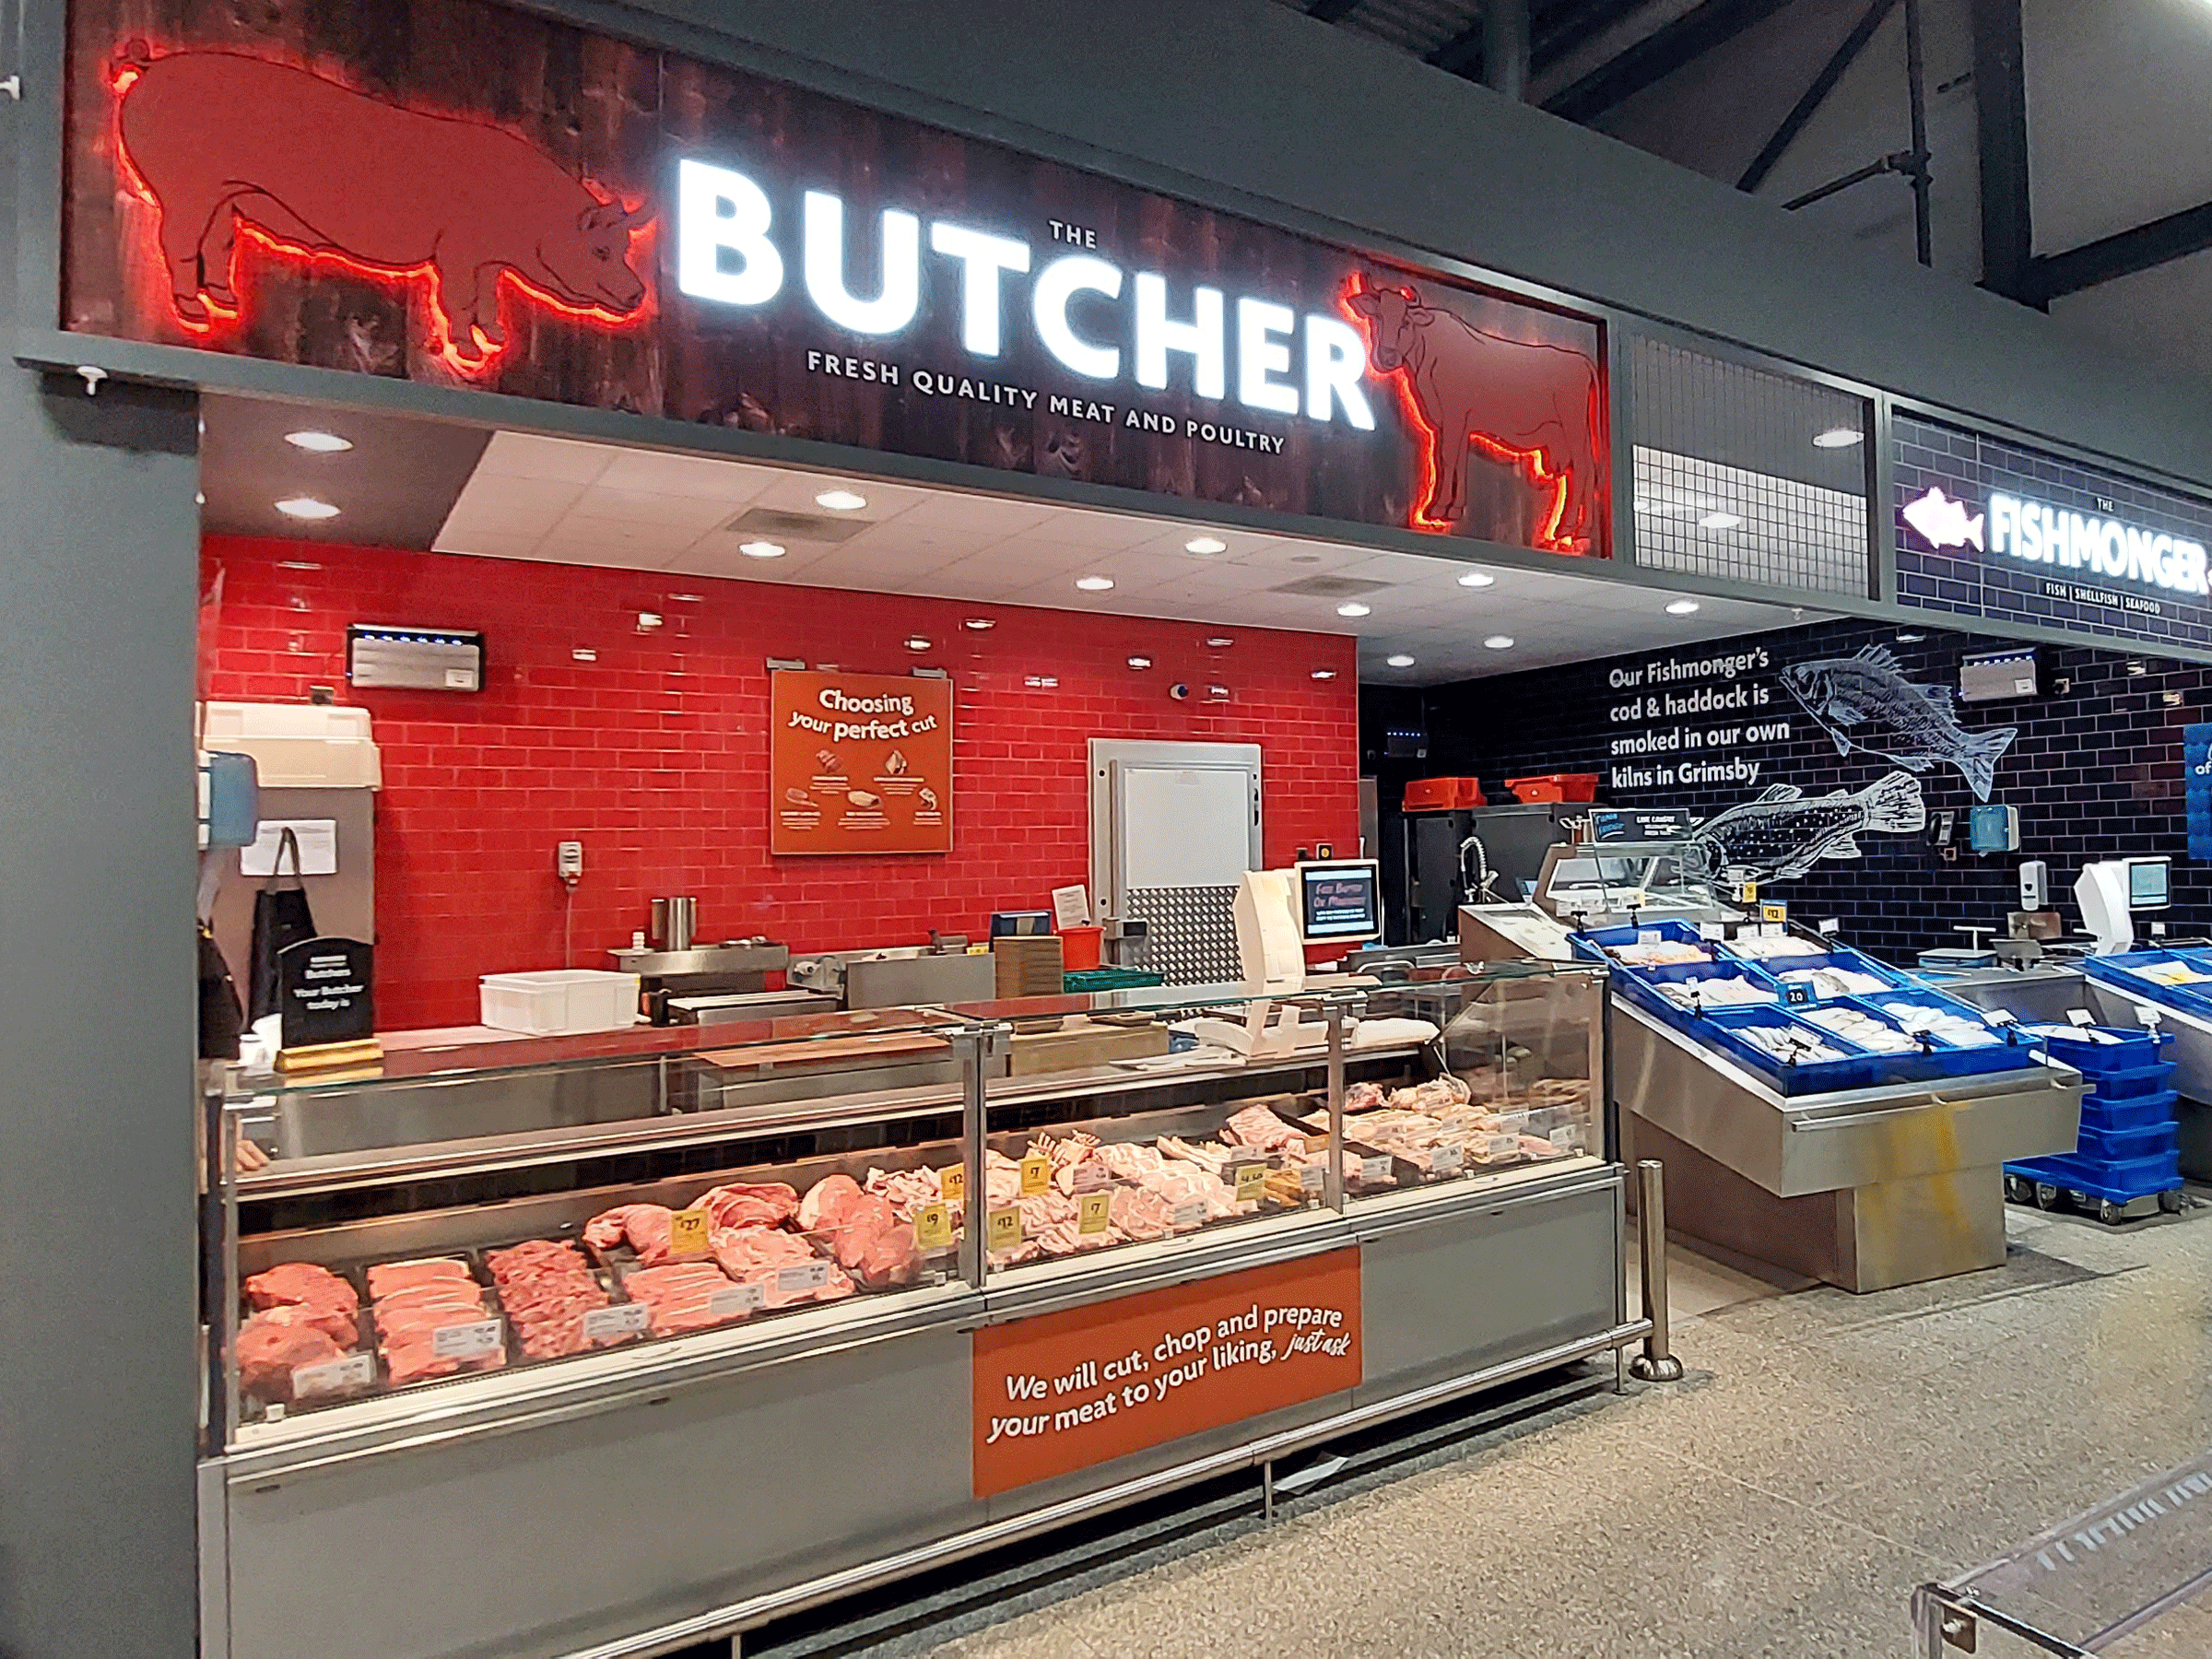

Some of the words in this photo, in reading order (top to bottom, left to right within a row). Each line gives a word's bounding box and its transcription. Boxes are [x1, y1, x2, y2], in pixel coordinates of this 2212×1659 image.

[1050, 219, 1097, 250] THE
[677, 159, 1377, 432] BUTCHER
[806, 350, 900, 386] FRESH
[912, 370, 1038, 411] QUALITY
[1049, 395, 1116, 424] MEAT
[1126, 408, 1177, 435] AND
[1185, 420, 1286, 455] POULTRY
[2097, 497, 2114, 512] THE
[1988, 492, 2210, 596] FISHMONGER
[2045, 582, 2067, 597] FISH
[2074, 587, 2119, 607] SHELLFISH
[2124, 598, 2161, 616] SEAFOOD
[1609, 668, 1643, 688] Our
[1647, 646, 1769, 683] Fishmonger's
[819, 688, 914, 716] Choosing
[1610, 697, 1641, 722] cod
[1647, 697, 1661, 717] &
[1665, 684, 1748, 716] haddock
[1753, 683, 1770, 705] is
[788, 712, 832, 734] your
[833, 719, 910, 742] perfect
[911, 714, 938, 733] cut
[1611, 726, 1679, 755] smoked
[1685, 727, 1702, 748] in
[1707, 727, 1741, 746] our
[1746, 723, 1790, 743] own
[1612, 764, 1653, 788] kilns
[1657, 765, 1674, 785] in
[1678, 757, 1760, 785] Grimsby
[1790, 991, 1804, 1002] 20
[1006, 1375, 1048, 1401] We
[1053, 1361, 1099, 1395] will
[1103, 1350, 1149, 1381] cut,
[1154, 1326, 1211, 1362] chop
[1218, 1305, 1258, 1338] and
[1264, 1307, 1343, 1335] prepare
[986, 1412, 1049, 1443] your
[1054, 1393, 1117, 1431] meat
[1122, 1382, 1149, 1407] to
[1154, 1357, 1208, 1401] your
[1211, 1339, 1277, 1371] liking,
[1280, 1329, 1322, 1361] just
[1322, 1330, 1352, 1357] ask
